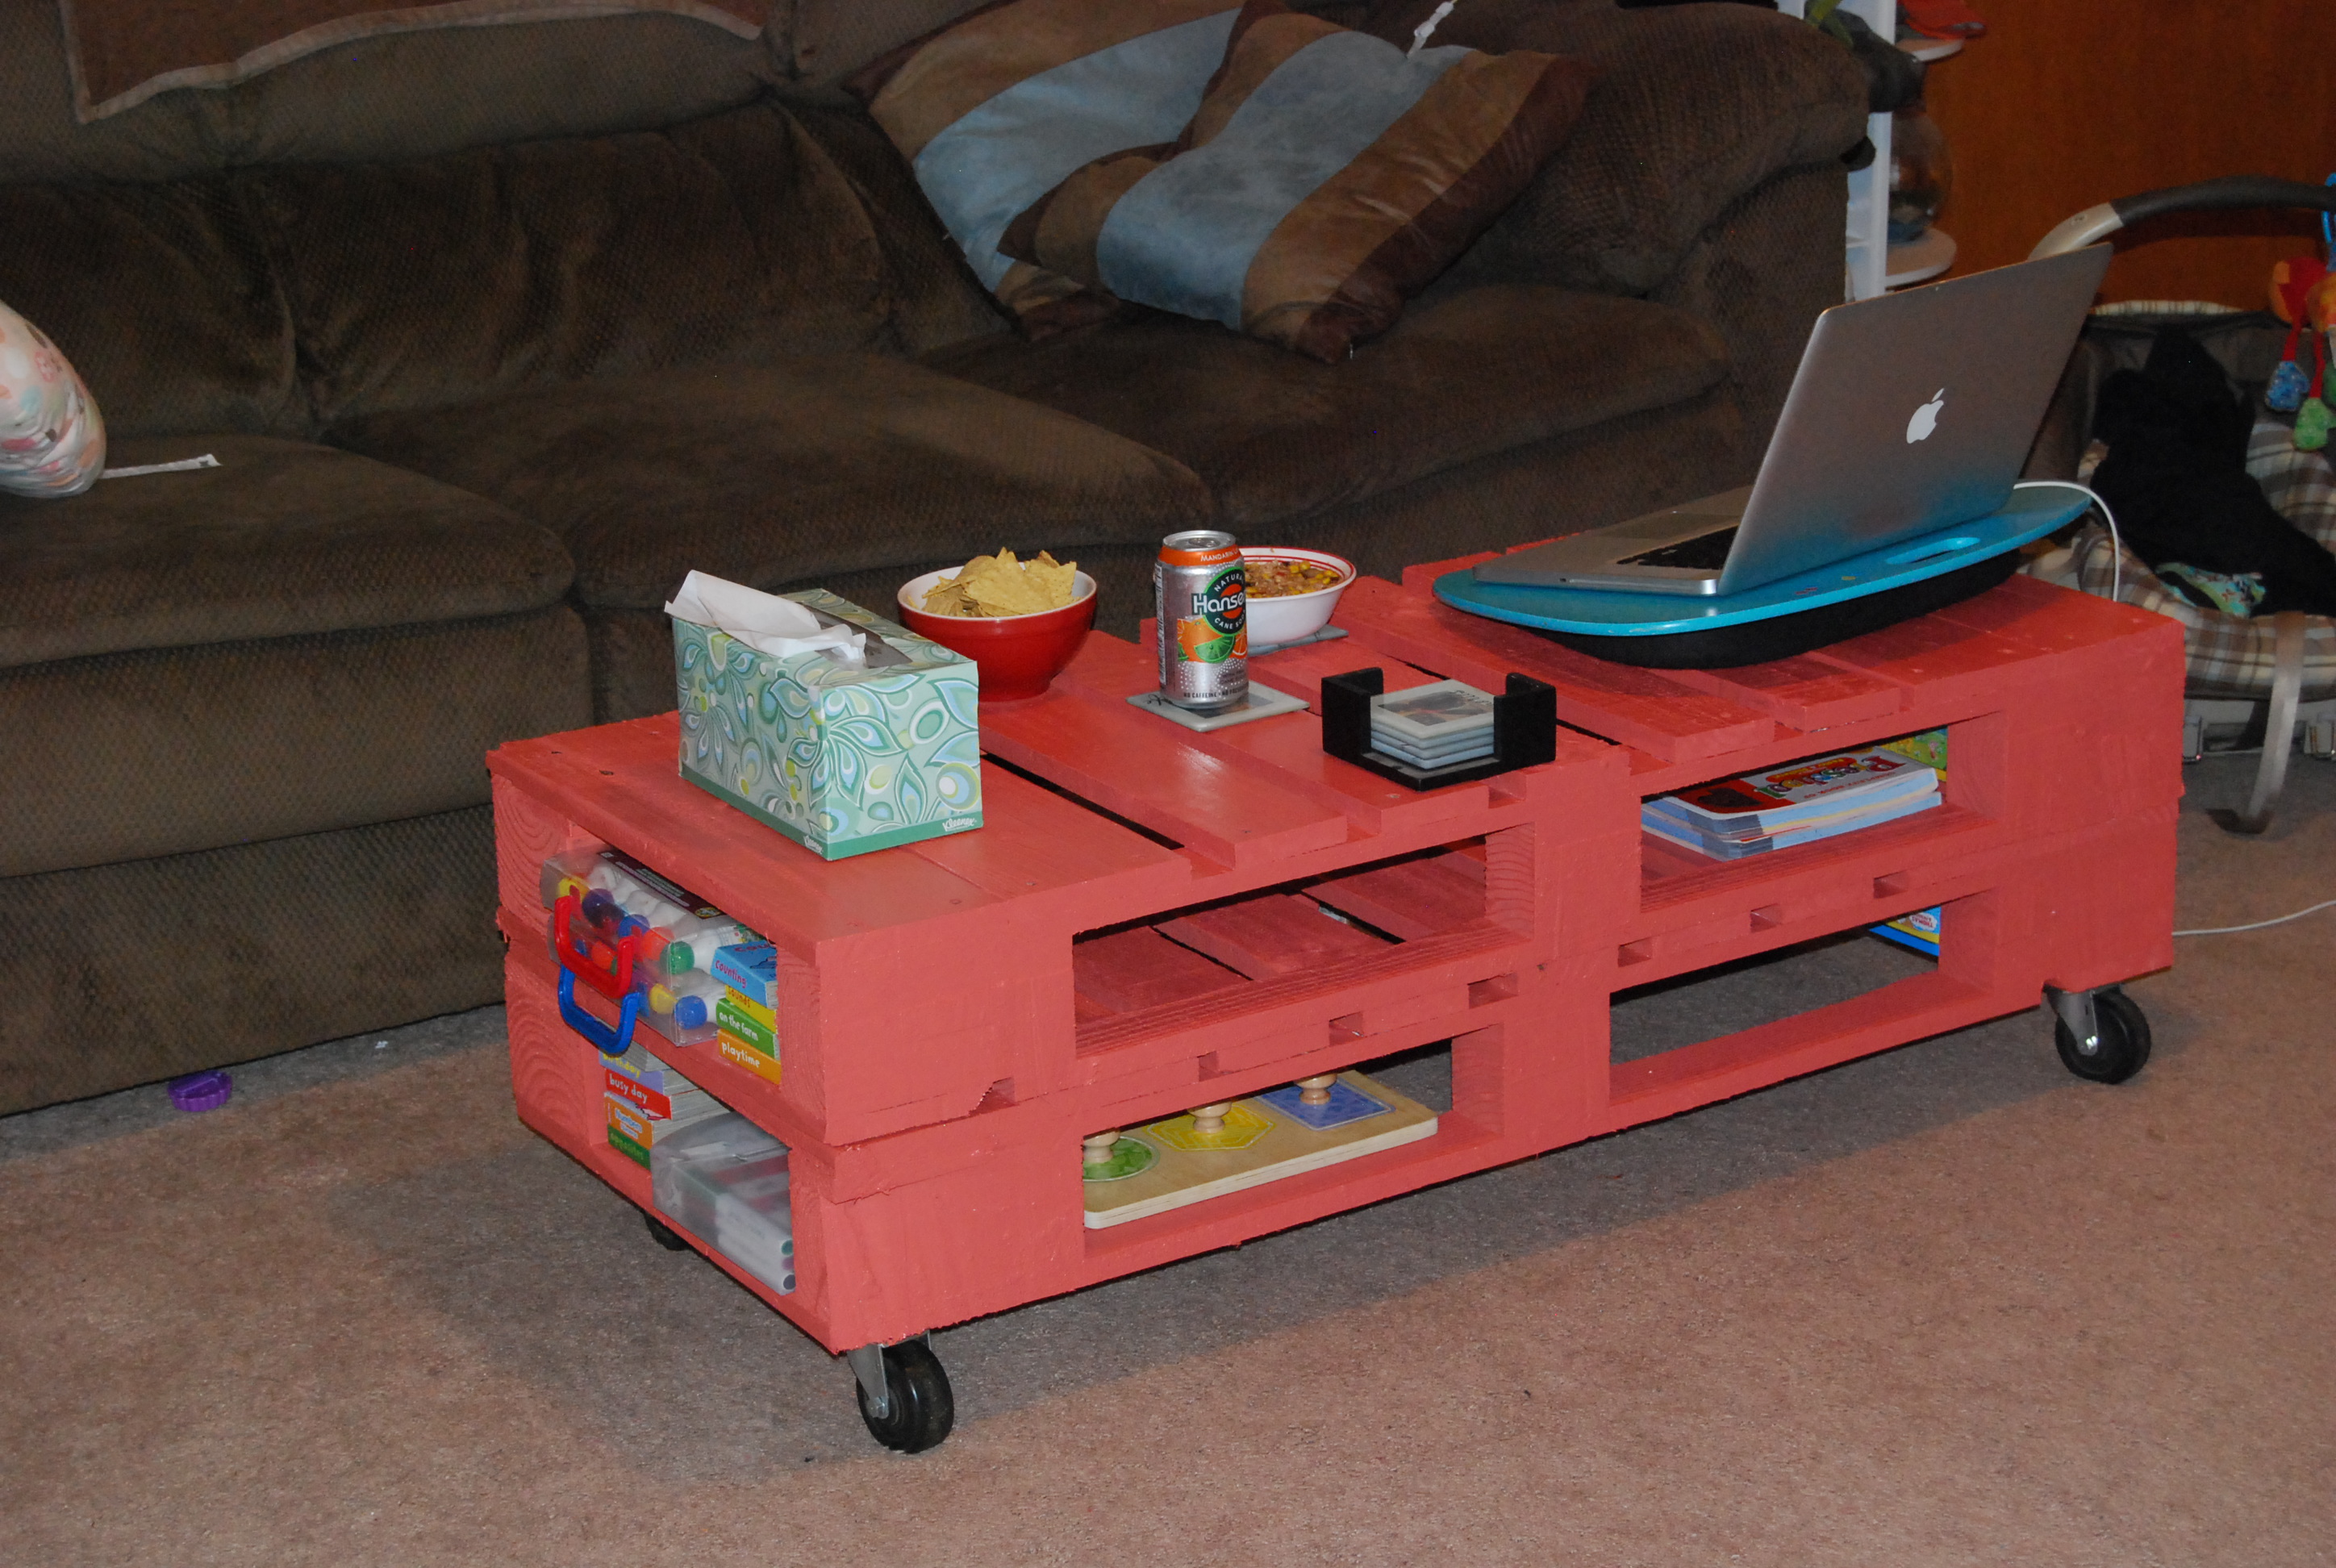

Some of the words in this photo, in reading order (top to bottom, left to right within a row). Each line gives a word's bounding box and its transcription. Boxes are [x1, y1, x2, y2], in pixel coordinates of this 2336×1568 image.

[1200, 551, 1233, 562] MANDARIN
[1193, 594, 1245, 614] Hanse
[1214, 617, 1233, 629] CANE
[942, 818, 975, 832] Kleenex
[719, 1011, 728, 1023] on
[728, 1014, 740, 1031] the
[741, 1022, 758, 1041] farm
[721, 1041, 761, 1068] playtime
[609, 1073, 629, 1095] busy
[631, 1084, 648, 1104] day
